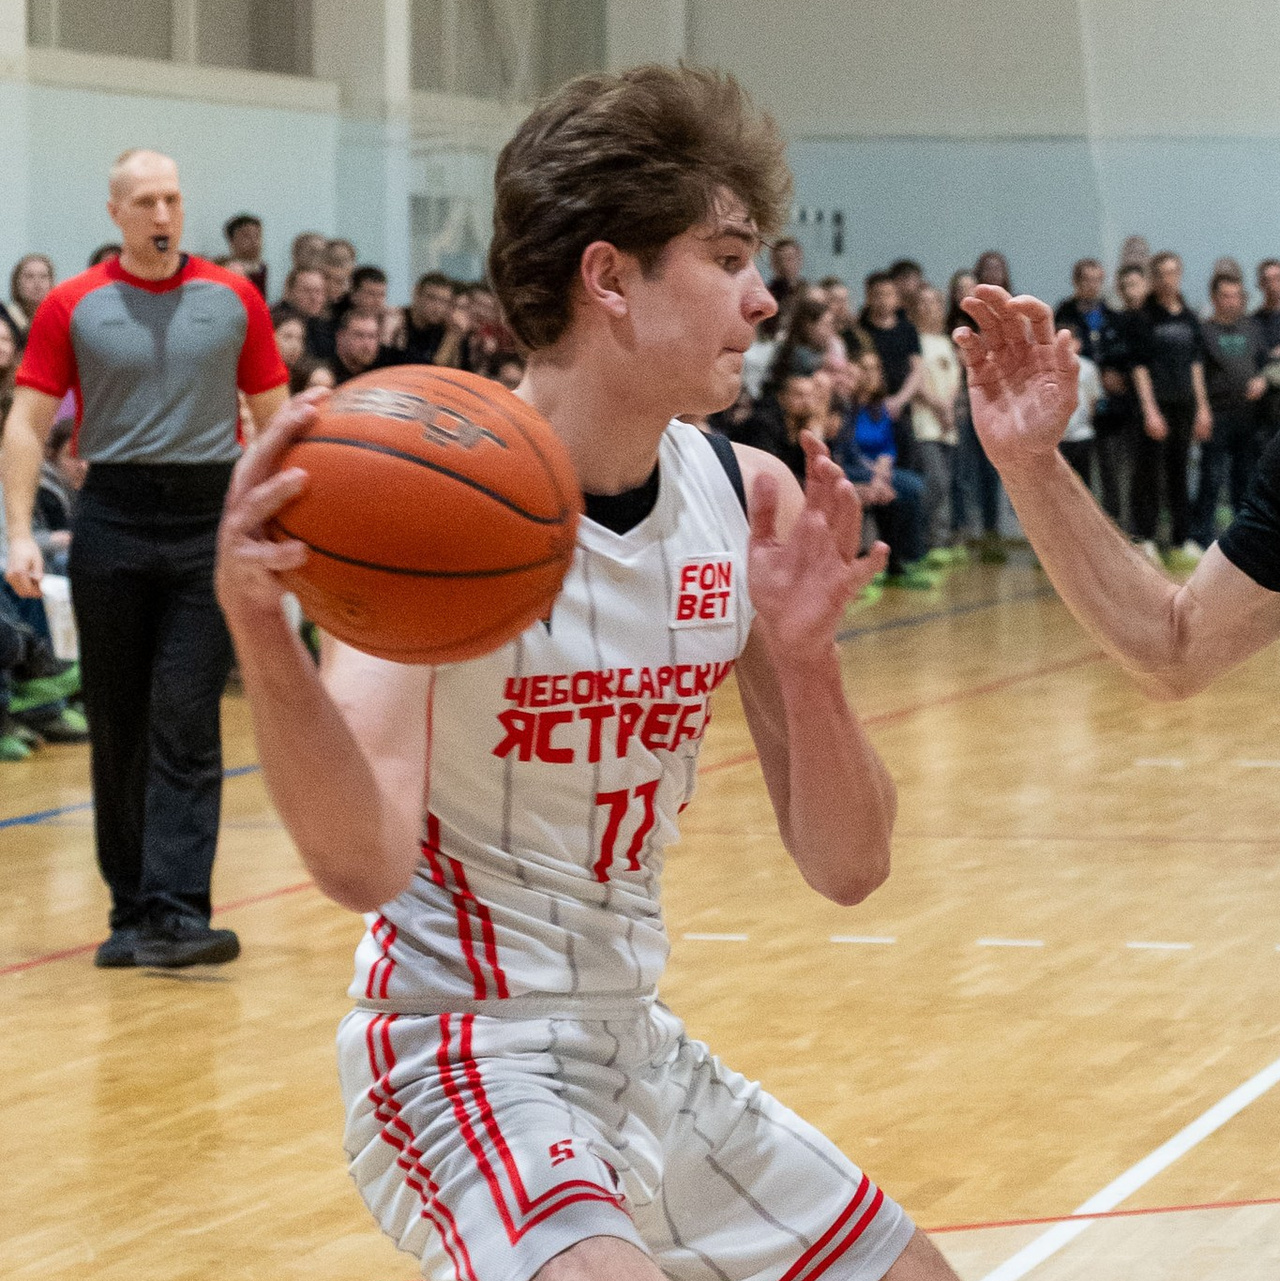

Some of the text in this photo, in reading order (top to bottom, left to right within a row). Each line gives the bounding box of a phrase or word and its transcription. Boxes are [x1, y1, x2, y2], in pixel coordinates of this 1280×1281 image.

[680, 561, 731, 591] FON
[676, 591, 730, 620] BET
[504, 659, 735, 708] ЧЕБОКСАРСКИ
